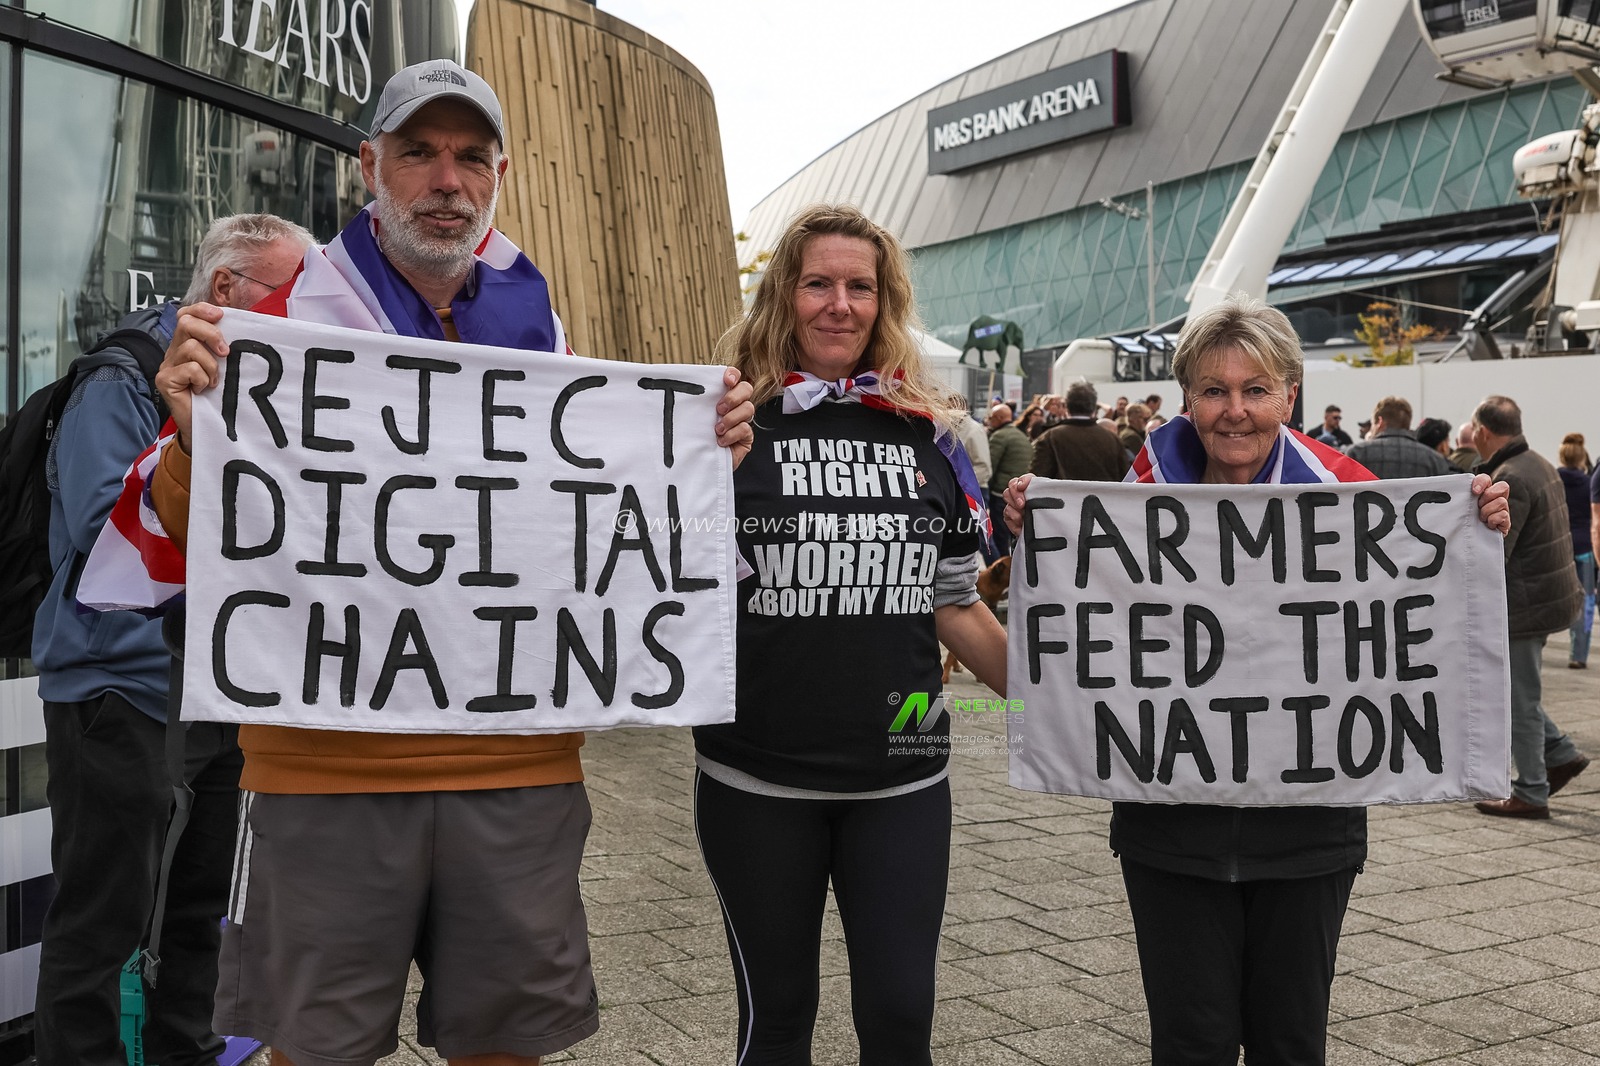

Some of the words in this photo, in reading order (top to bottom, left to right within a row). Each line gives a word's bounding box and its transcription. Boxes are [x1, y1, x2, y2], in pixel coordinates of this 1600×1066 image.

[419, 73, 450, 81] NORTH
[934, 117, 972, 152] M&S
[973, 99, 1028, 141] BANK
[1028, 78, 1100, 124] ARENA
[222, 339, 705, 469] REJECT
[773, 438, 812, 463] I'M
[818, 438, 867, 463] NOT
[873, 442, 917, 467] FAR
[781, 461, 919, 500] RIGHT!
[221, 459, 719, 597] DIGITAL
[798, 512, 838, 541] I'M
[846, 512, 909, 541] JUST
[1024, 490, 1452, 588] FARMERS
[747, 587, 833, 617] ABOUT
[838, 586, 881, 615] MY
[753, 542, 938, 588] WORRIED
[212, 590, 684, 712] CHAINS
[1026, 602, 1225, 689] FEED
[1279, 594, 1438, 684] THE
[1095, 691, 1444, 785] NATION
